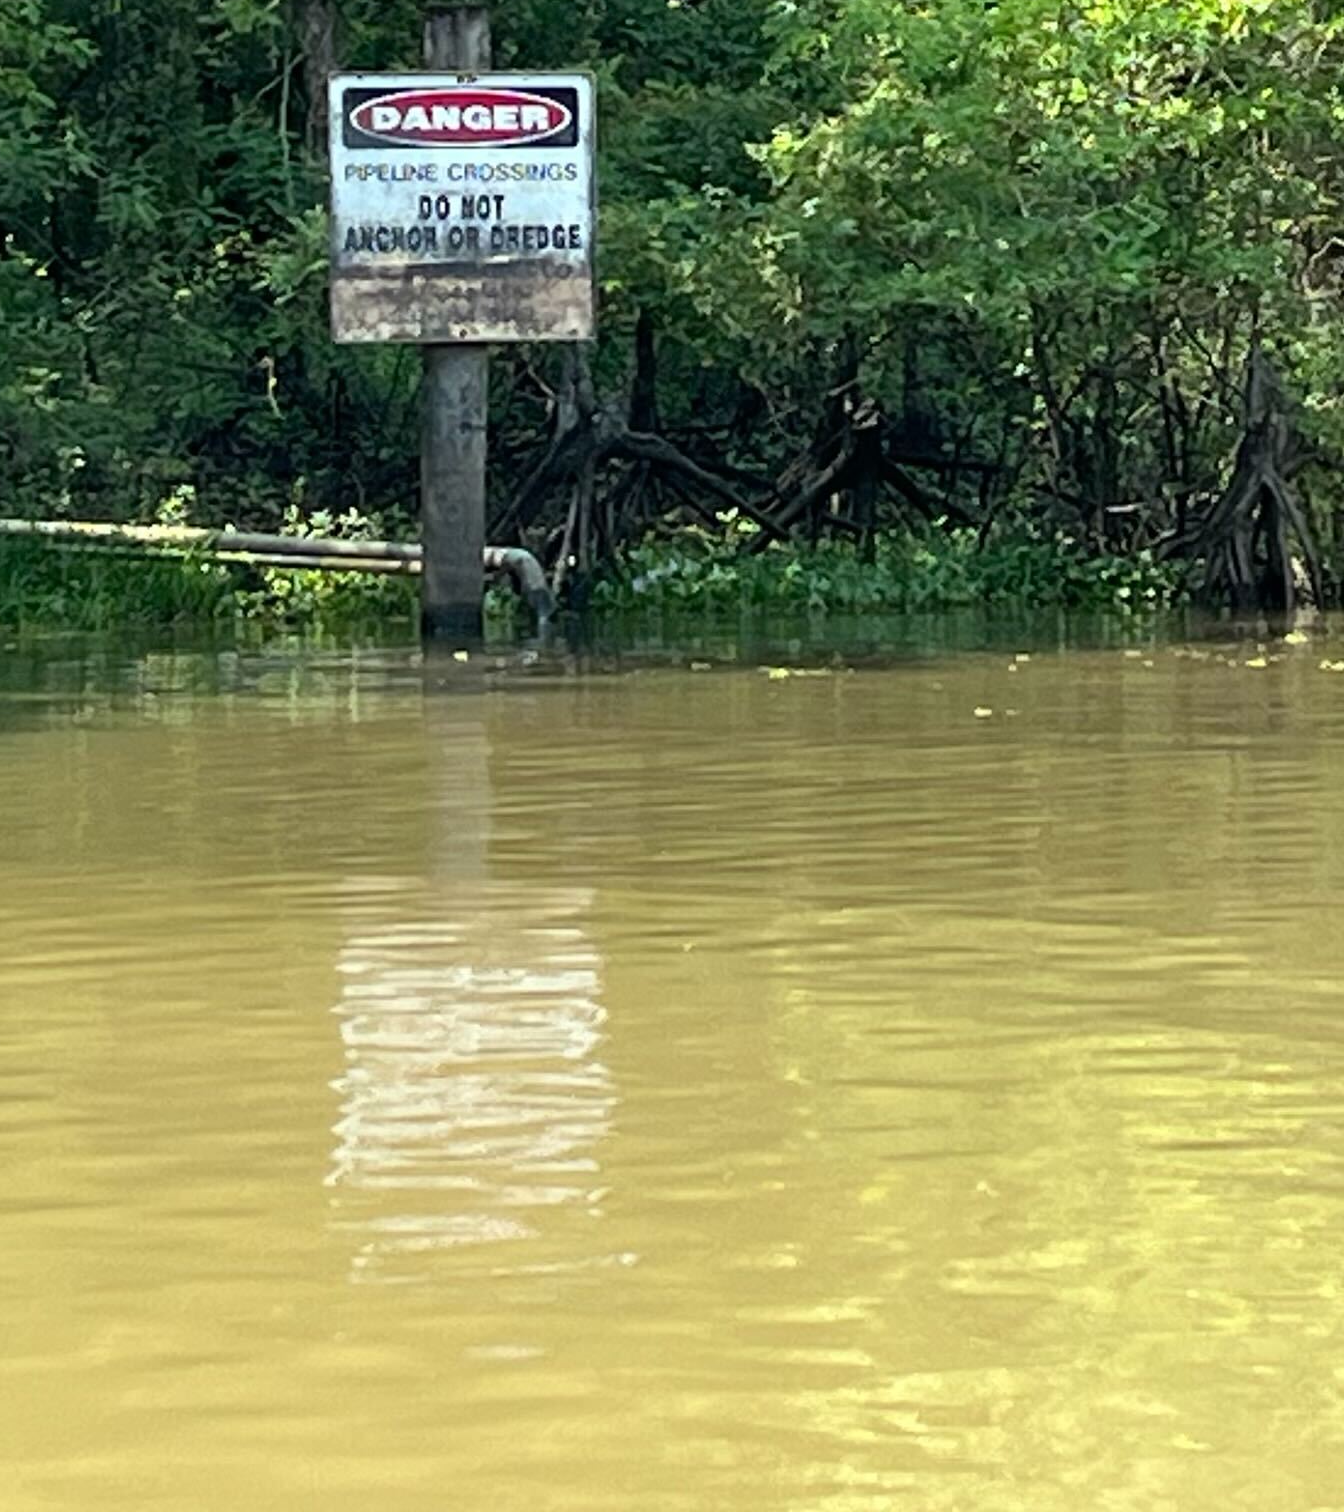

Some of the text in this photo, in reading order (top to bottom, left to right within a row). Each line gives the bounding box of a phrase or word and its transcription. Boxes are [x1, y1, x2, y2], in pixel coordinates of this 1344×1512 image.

[371, 105, 550, 131] DANGER
[344, 162, 578, 182] PIPELINE CROSSINGS
[418, 194, 505, 220] DO NOT
[343, 224, 582, 252] ANCHOR OR DREDGE
